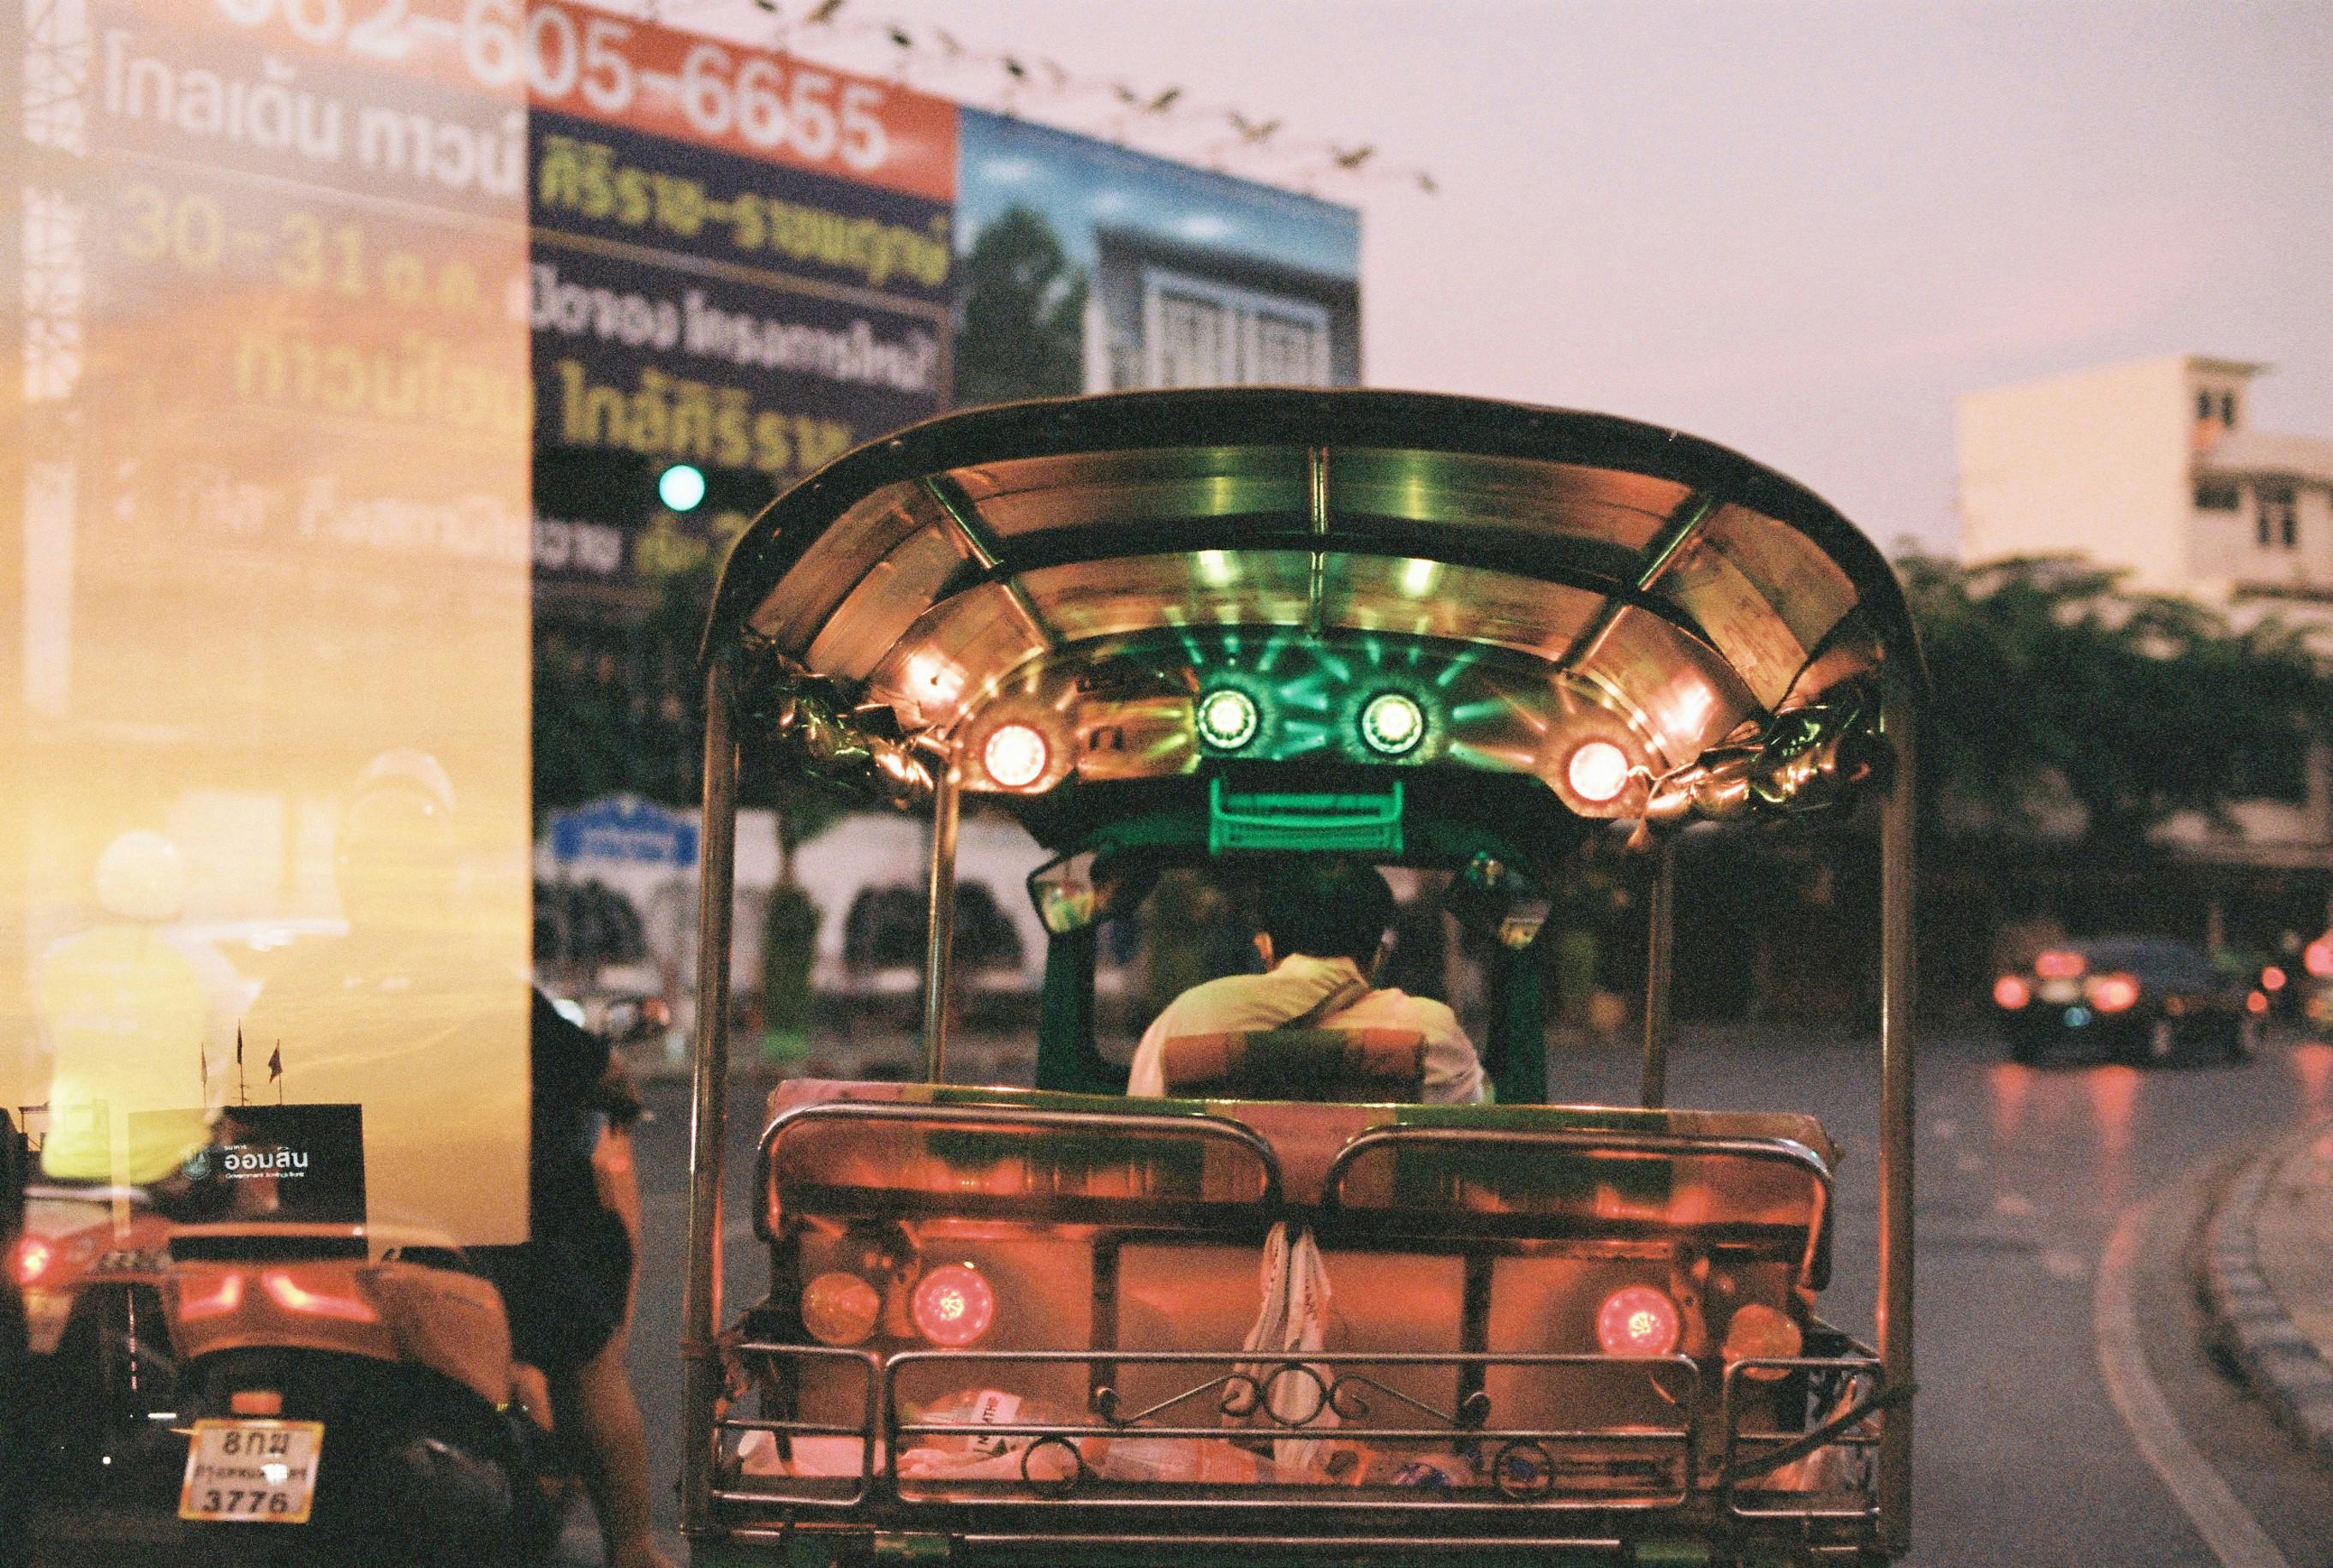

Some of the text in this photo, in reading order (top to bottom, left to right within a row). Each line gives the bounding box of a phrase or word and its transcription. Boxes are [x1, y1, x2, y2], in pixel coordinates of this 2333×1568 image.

[117, 183, 368, 297] 30-31
[224, 1146, 308, 1171] ออมสิน
[202, 1487, 290, 1514] 3776
